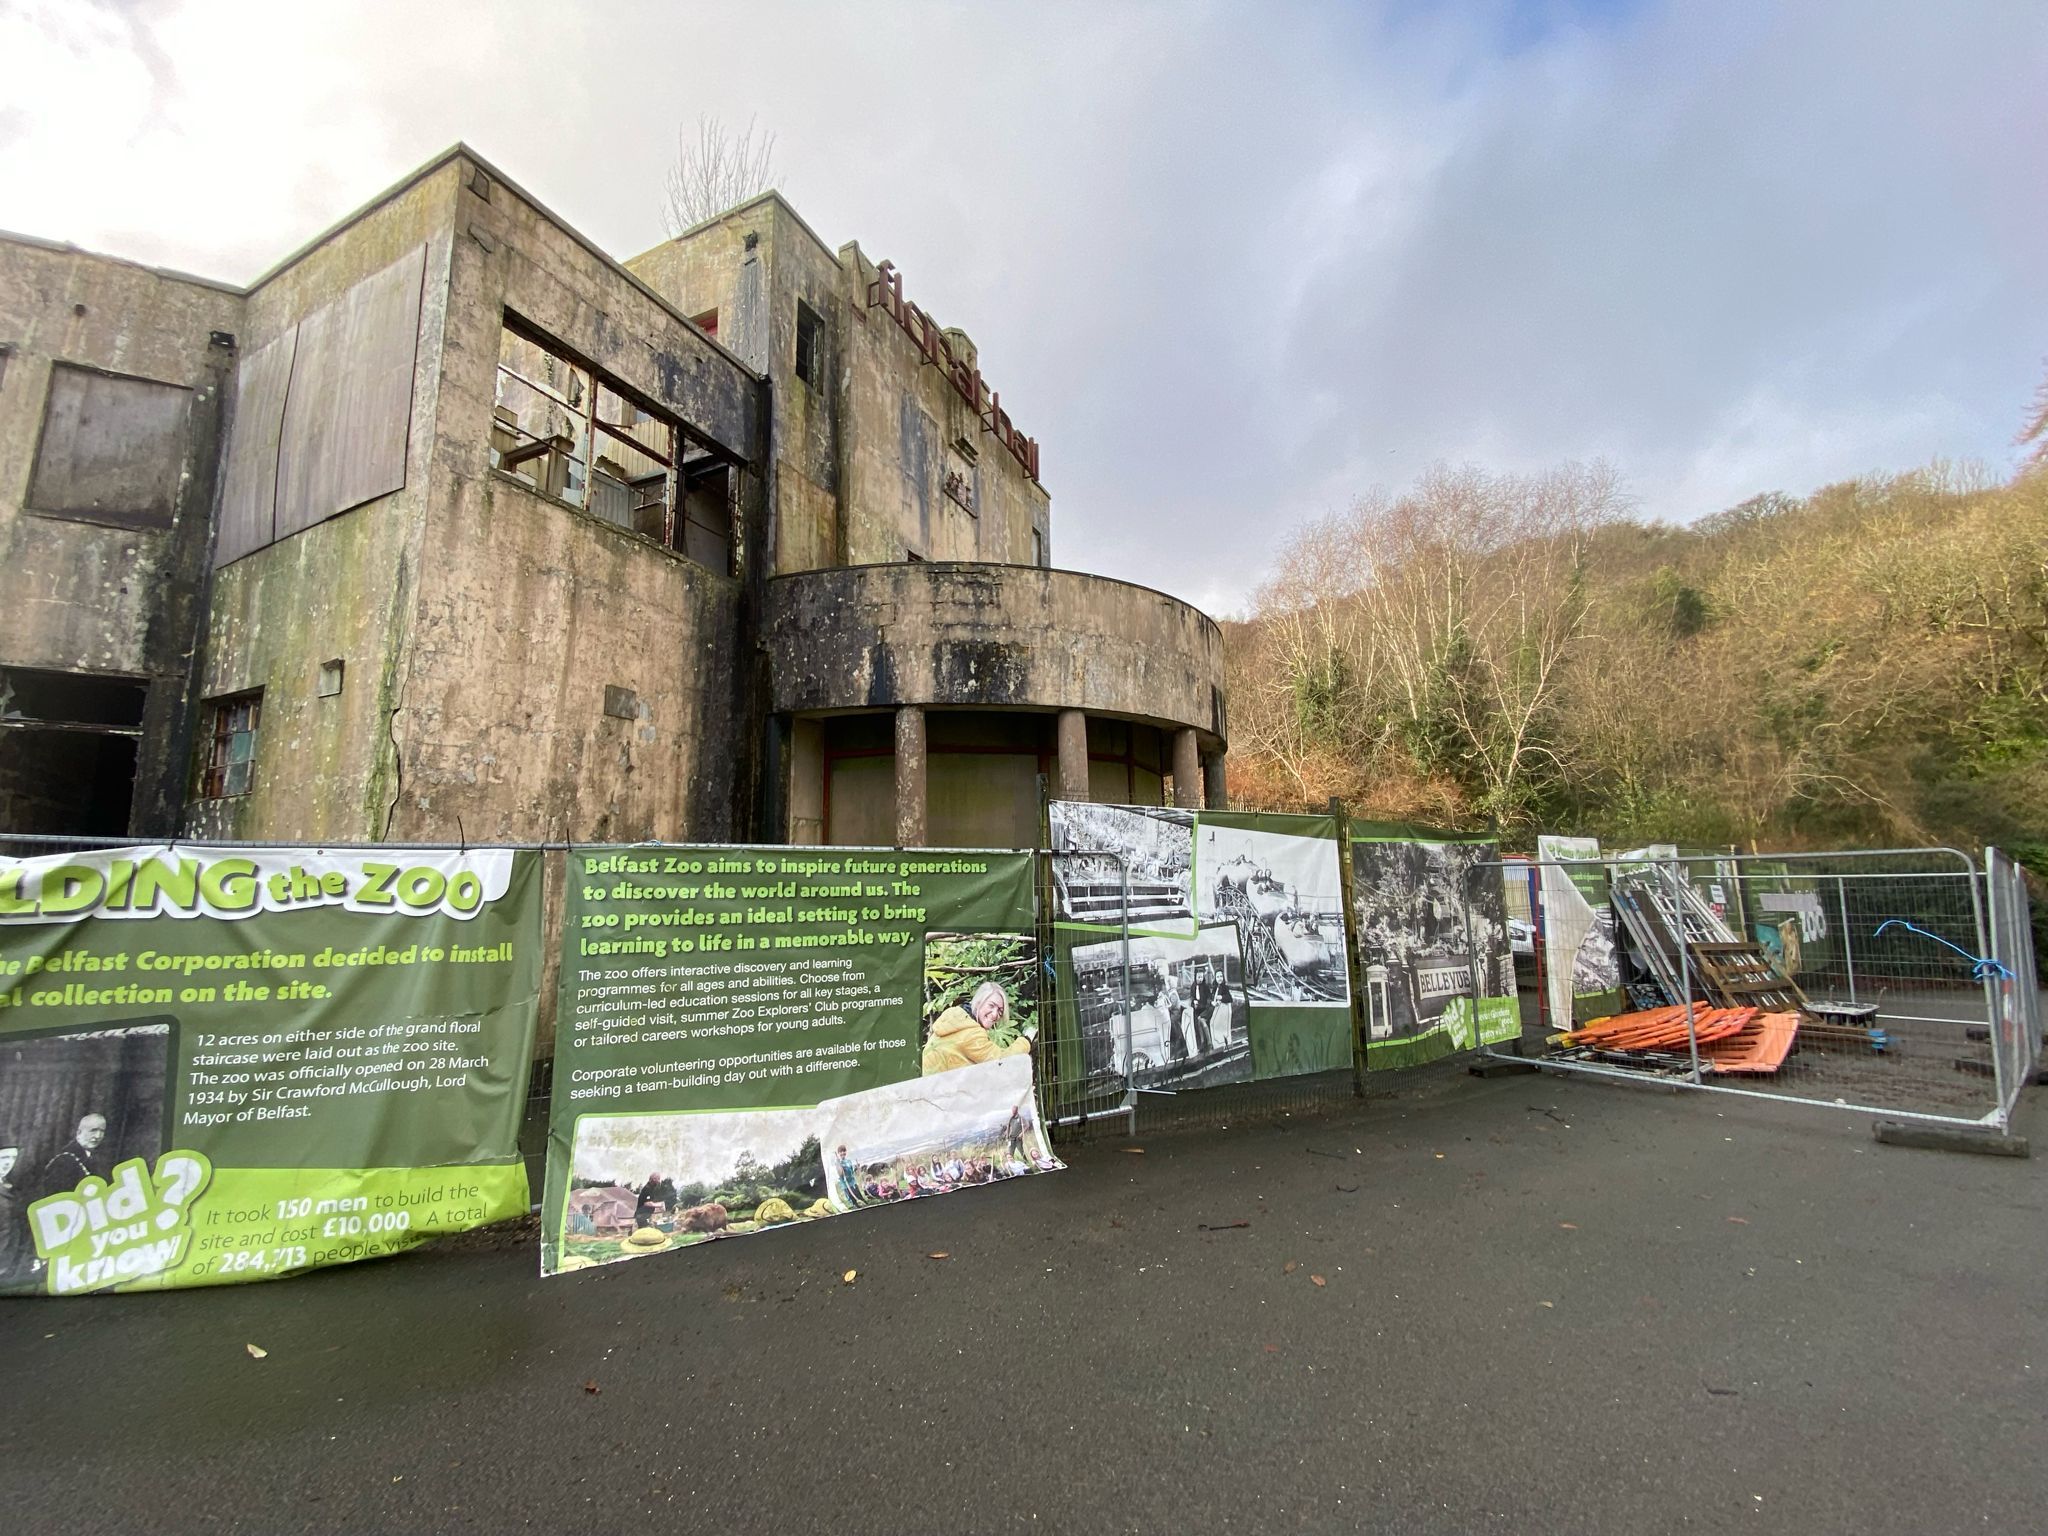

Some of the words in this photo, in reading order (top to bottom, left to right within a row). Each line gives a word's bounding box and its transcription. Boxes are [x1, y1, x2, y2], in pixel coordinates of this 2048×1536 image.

[585, 856, 659, 875] Belfast
[664, 857, 702, 874] Zoo
[707, 857, 751, 874] aims
[756, 858, 777, 874] to
[781, 858, 841, 878] inspire
[844, 858, 896, 874] future
[900, 859, 987, 877] generations
[267, 865, 346, 901] the
[583, 885, 607, 901] to
[611, 882, 699, 899] discover
[704, 881, 737, 899] the
[741, 882, 797, 898] world
[800, 881, 862, 898] around
[866, 885, 889, 897] us.
[892, 881, 921, 896] The
[581, 914, 619, 929] zoo
[624, 908, 715, 931] provides
[719, 912, 743, 924] an
[747, 906, 793, 924] ideal
[797, 906, 857, 925] setting
[861, 907, 880, 920] to
[884, 904, 927, 922] bring
[580, 936, 667, 958] learning
[671, 937, 694, 952] to
[699, 934, 732, 951] life
[737, 933, 755, 950] in
[759, 937, 770, 949] a
[775, 929, 874, 948] memorable
[877, 931, 914, 946] way.
[24, 950, 128, 975] Belfast
[136, 948, 305, 976] Corporation
[313, 945, 418, 968] decided
[421, 946, 445, 962] to
[450, 943, 513, 962] install
[579, 969, 601, 982] The
[604, 969, 627, 980] zoo
[631, 967, 667, 979] offers
[671, 964, 731, 977] interactive
[733, 962, 787, 974] discovery
[789, 959, 810, 970] and
[812, 958, 853, 970] learning
[31, 983, 172, 1006] collection
[180, 988, 216, 1003] on
[223, 981, 269, 1001] the
[277, 980, 332, 1000] site.
[576, 998, 666, 1015] curriculum-led
[669, 995, 728, 1008] education
[731, 991, 780, 1004] sessions
[783, 989, 797, 1000] for
[800, 988, 812, 999] all
[814, 987, 833, 999] key
[835, 984, 872, 997] stages,
[874, 984, 881, 993] a
[577, 983, 657, 1000] programmes
[660, 981, 678, 993] for
[680, 981, 694, 992] all
[697, 981, 725, 993] ages
[728, 977, 750, 989] and
[752, 975, 797, 987] abilities.
[800, 972, 840, 984] Choose
[842, 971, 865, 981] from
[574, 1015, 646, 1031] self-guided
[649, 1012, 677, 1025] visit,
[680, 1010, 729, 1023] summer
[732, 1007, 755, 1019] Zoo
[814, 1001, 839, 1012] Club
[841, 996, 904, 1012] programmes
[198, 1034, 215, 1047] 12
[219, 1034, 258, 1046] acres
[262, 1033, 282, 1044] on
[286, 1029, 331, 1043] either
[335, 1027, 366, 1040] side
[369, 1024, 386, 1038] of
[386, 1024, 403, 1037] the
[405, 1022, 446, 1037] grand
[449, 1021, 481, 1033] floral
[573, 1037, 587, 1048] or
[591, 1032, 638, 1046] tailored
[642, 1029, 688, 1042] careers
[691, 1023, 755, 1038] workshops
[757, 1021, 773, 1032] for
[775, 1019, 809, 1032] young
[811, 1015, 846, 1027] adults.
[192, 1052, 259, 1066] staircase
[262, 1050, 301, 1063] were
[305, 1046, 334, 1060] laid
[336, 1046, 362, 1058] out
[365, 1046, 379, 1056] as
[382, 1042, 400, 1054] the
[402, 1042, 429, 1053] zoo
[433, 1040, 459, 1051] site.
[572, 1065, 637, 1082] Corporate
[641, 1058, 715, 1075] volunteering
[719, 1050, 793, 1068] opportunities
[796, 1048, 813, 1059] are
[815, 1042, 861, 1056] available
[863, 1041, 877, 1051] for
[879, 1038, 906, 1049] those
[190, 1071, 219, 1085] The
[221, 1073, 250, 1084] zoo
[254, 1070, 285, 1082] was
[288, 1064, 352, 1080] officially
[355, 1059, 403, 1077] opened
[407, 1060, 425, 1070] on
[429, 1057, 446, 1069] 28
[449, 1056, 489, 1068] March
[570, 1085, 621, 1100] seeking
[624, 1084, 633, 1093] a
[636, 1074, 721, 1093] team-building
[724, 1070, 745, 1083] day
[748, 1069, 767, 1080] out
[770, 1065, 793, 1077] with
[796, 1066, 803, 1074] a
[805, 1058, 860, 1073] difference.
[188, 1091, 224, 1105] 1934
[228, 1091, 248, 1106] by
[252, 1088, 273, 1101] Sir
[276, 1083, 346, 1099] Crawford
[349, 1076, 432, 1094] McCullough,
[436, 1074, 467, 1088] Lord
[183, 1112, 232, 1127] Mayor
[236, 1107, 256, 1122] of
[257, 1105, 311, 1120] Belfast.
[207, 1211, 220, 1225] It
[227, 1204, 271, 1224] took
[277, 1198, 312, 1220] 150
[315, 1196, 368, 1214] men
[374, 1194, 394, 1208] to
[398, 1185, 443, 1207] build
[449, 1183, 479, 1198] the
[91, 1221, 148, 1257] you
[200, 1235, 233, 1250] site
[239, 1227, 276, 1246] and
[281, 1226, 318, 1242] cost
[426, 1211, 439, 1226] A
[447, 1202, 487, 1223] total
[56, 1234, 182, 1293] know
[192, 1256, 218, 1275] of
[312, 1240, 380, 1266] people
